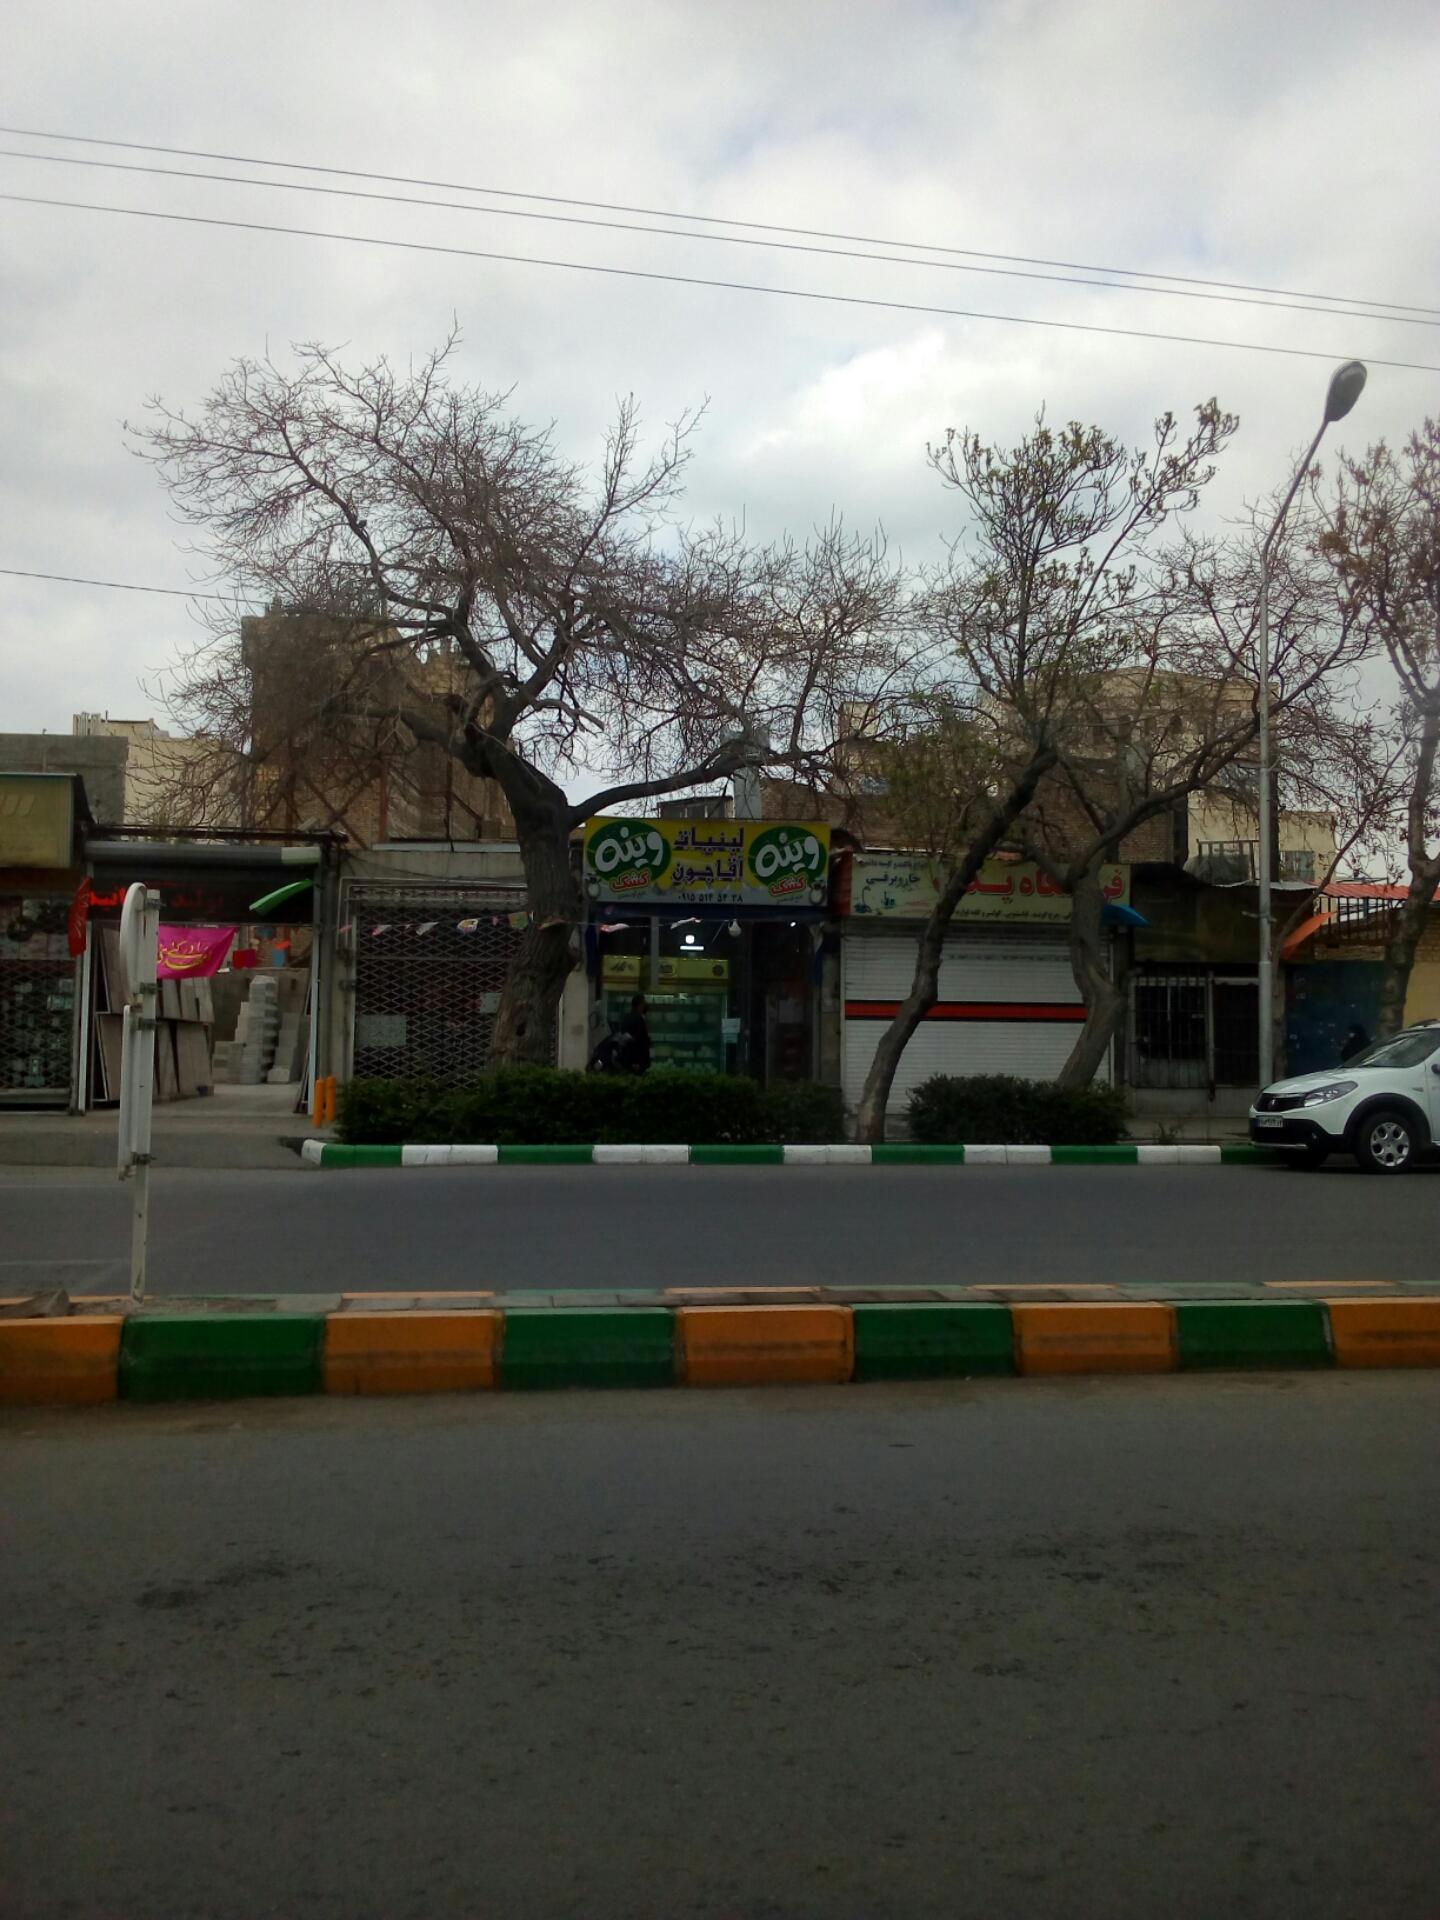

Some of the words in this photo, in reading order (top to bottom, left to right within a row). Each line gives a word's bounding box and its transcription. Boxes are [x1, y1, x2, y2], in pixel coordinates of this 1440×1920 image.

[594, 826, 664, 872] وینه
[674, 827, 744, 855] لبنیات
[755, 832, 820, 878] وینه
